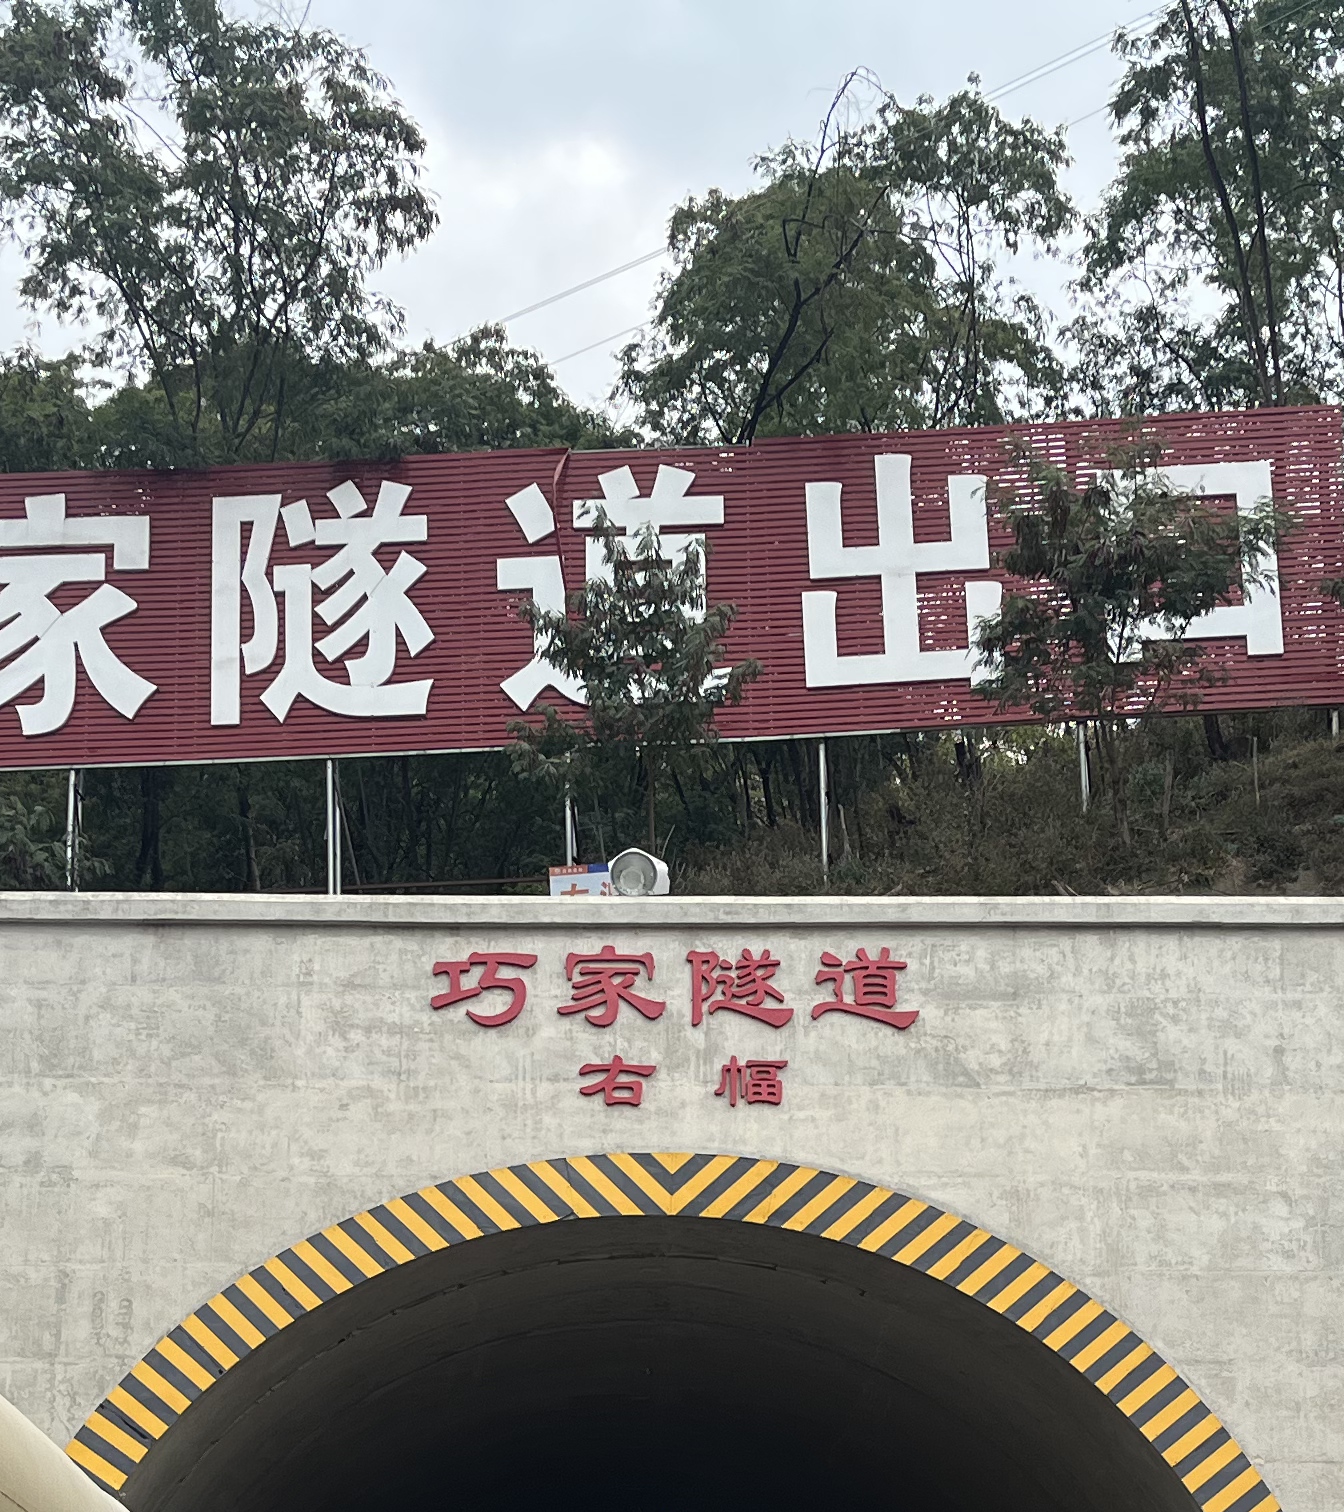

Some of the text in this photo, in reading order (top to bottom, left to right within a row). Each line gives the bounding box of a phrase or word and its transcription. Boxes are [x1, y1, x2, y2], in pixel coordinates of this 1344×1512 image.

[430, 944, 920, 1031] 巧家隧道
[578, 1054, 789, 1108] 右幅
